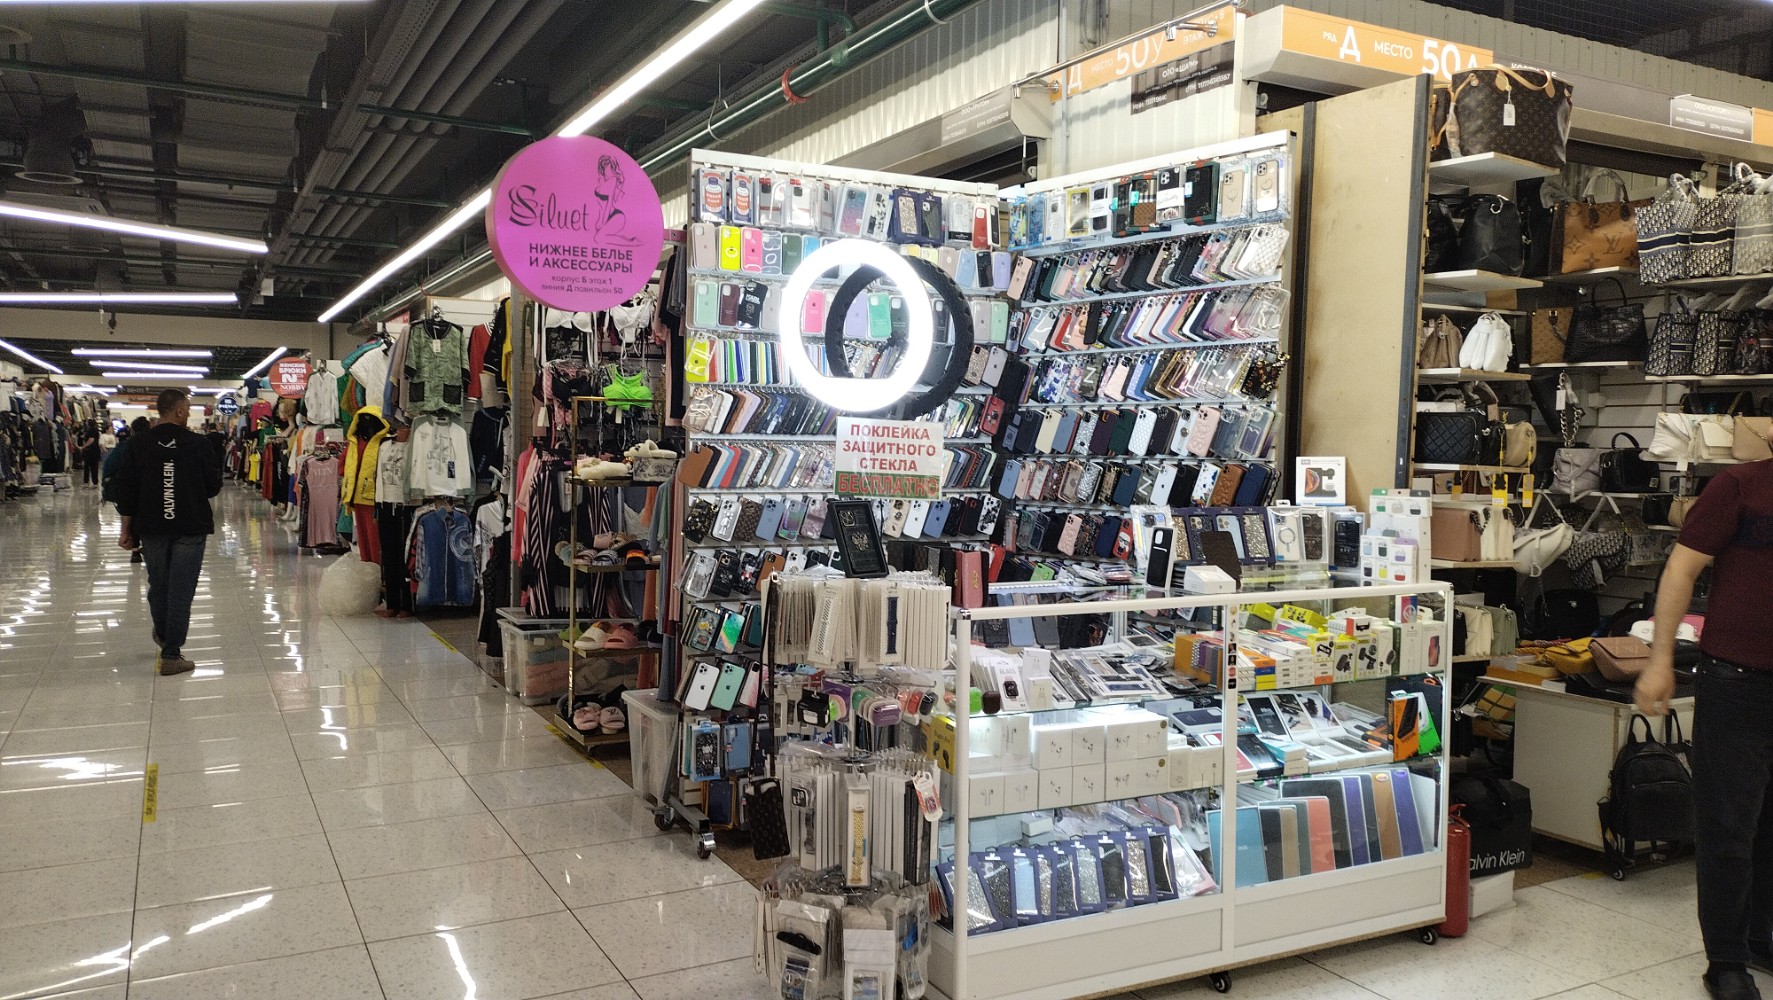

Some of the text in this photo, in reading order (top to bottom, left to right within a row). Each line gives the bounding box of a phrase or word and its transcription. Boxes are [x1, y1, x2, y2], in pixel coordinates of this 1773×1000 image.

[1322, 31, 1337, 43] РЯД
[1339, 25, 1361, 62] Д
[1374, 39, 1413, 60] МЕСТО
[1091, 57, 1114, 73] МЕСТО
[508, 184, 590, 232] Siluet
[529, 243, 634, 261] НИЖНЕЕ БЕЛЬЕ
[529, 256, 633, 273] И АКСЕССУАРЫ
[551, 275, 613, 285] корпус Б этаж 1
[566, 284, 573, 292] Д
[850, 423, 930, 441] ПОКЛЕЙКА
[843, 440, 936, 457] ЗАЩИТНОГО
[859, 457, 918, 472] СТЕКЛА
[838, 474, 937, 497] БЕСПЛАТНО
[163, 485, 175, 520] CALVIN
[1469, 848, 1525, 871] alvin Klein
